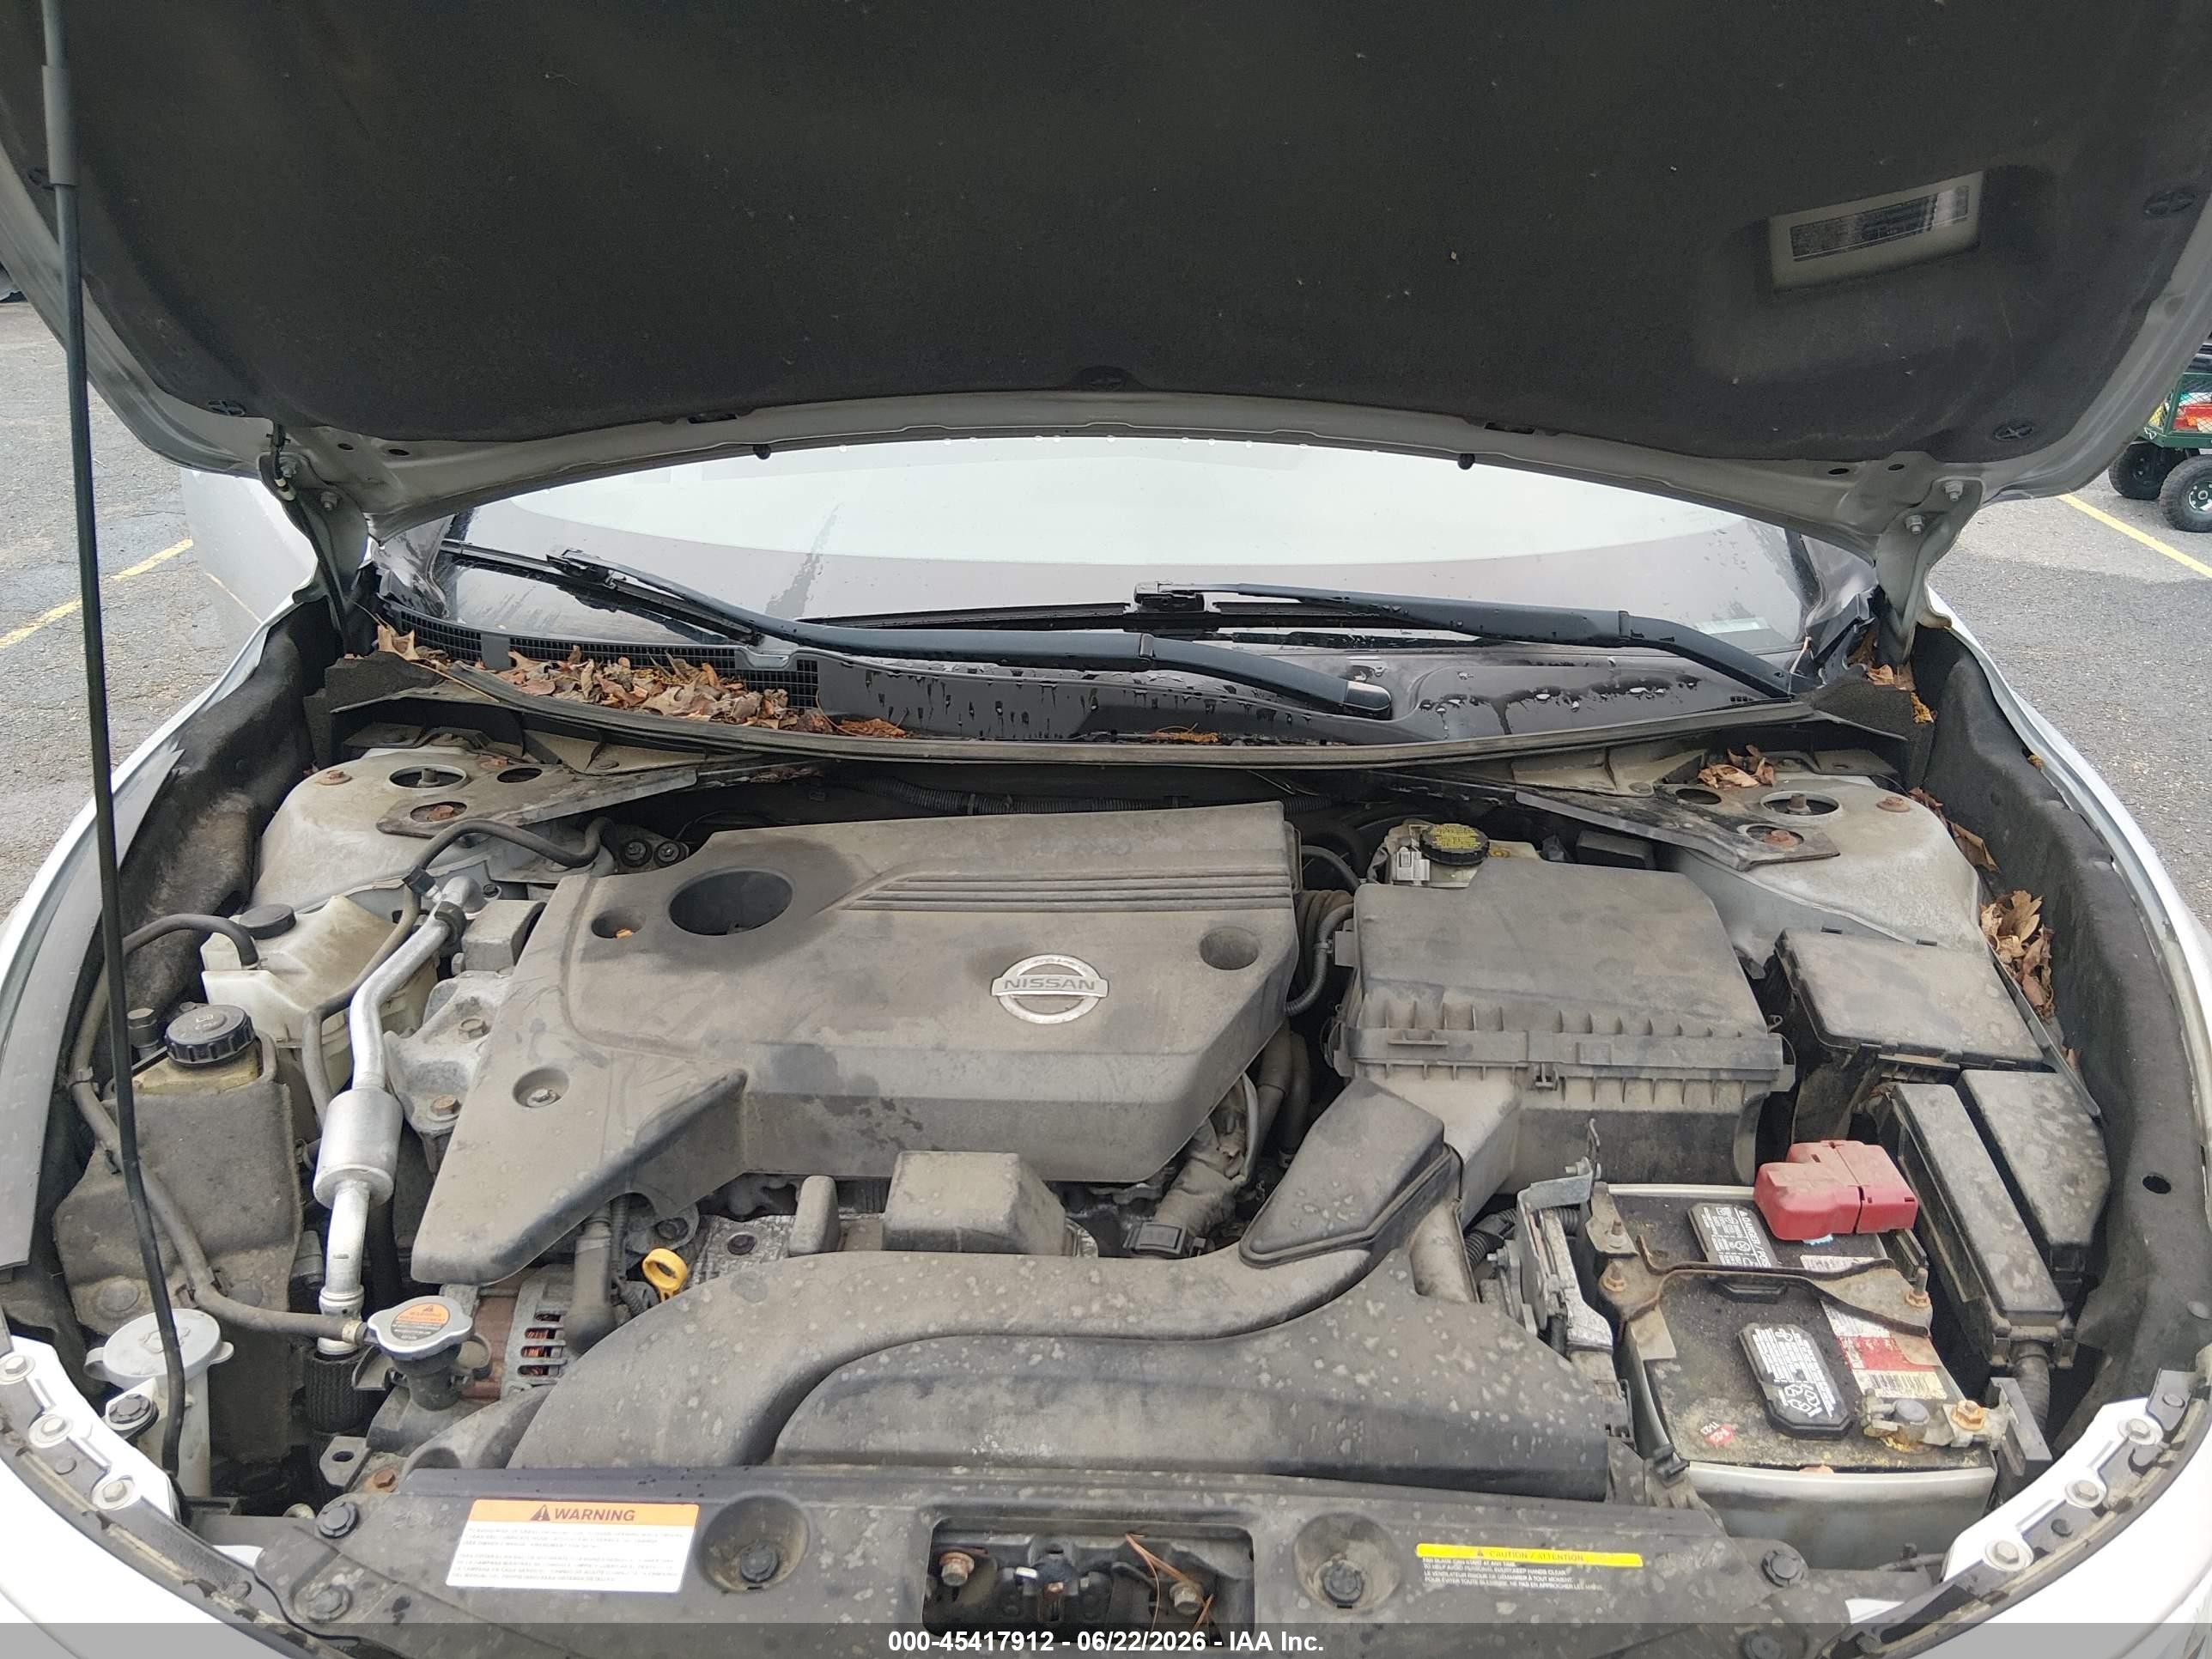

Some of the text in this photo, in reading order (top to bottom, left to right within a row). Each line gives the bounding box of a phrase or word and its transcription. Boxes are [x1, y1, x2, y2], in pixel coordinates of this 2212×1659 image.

[1004, 977, 1095, 990] NISSAN
[1741, 1216, 1761, 1245] DANGER
[555, 1508, 635, 1522] WARNING
[1489, 1550, 1528, 1559] CAUTION
[1537, 1553, 1584, 1562] ATTENTION
